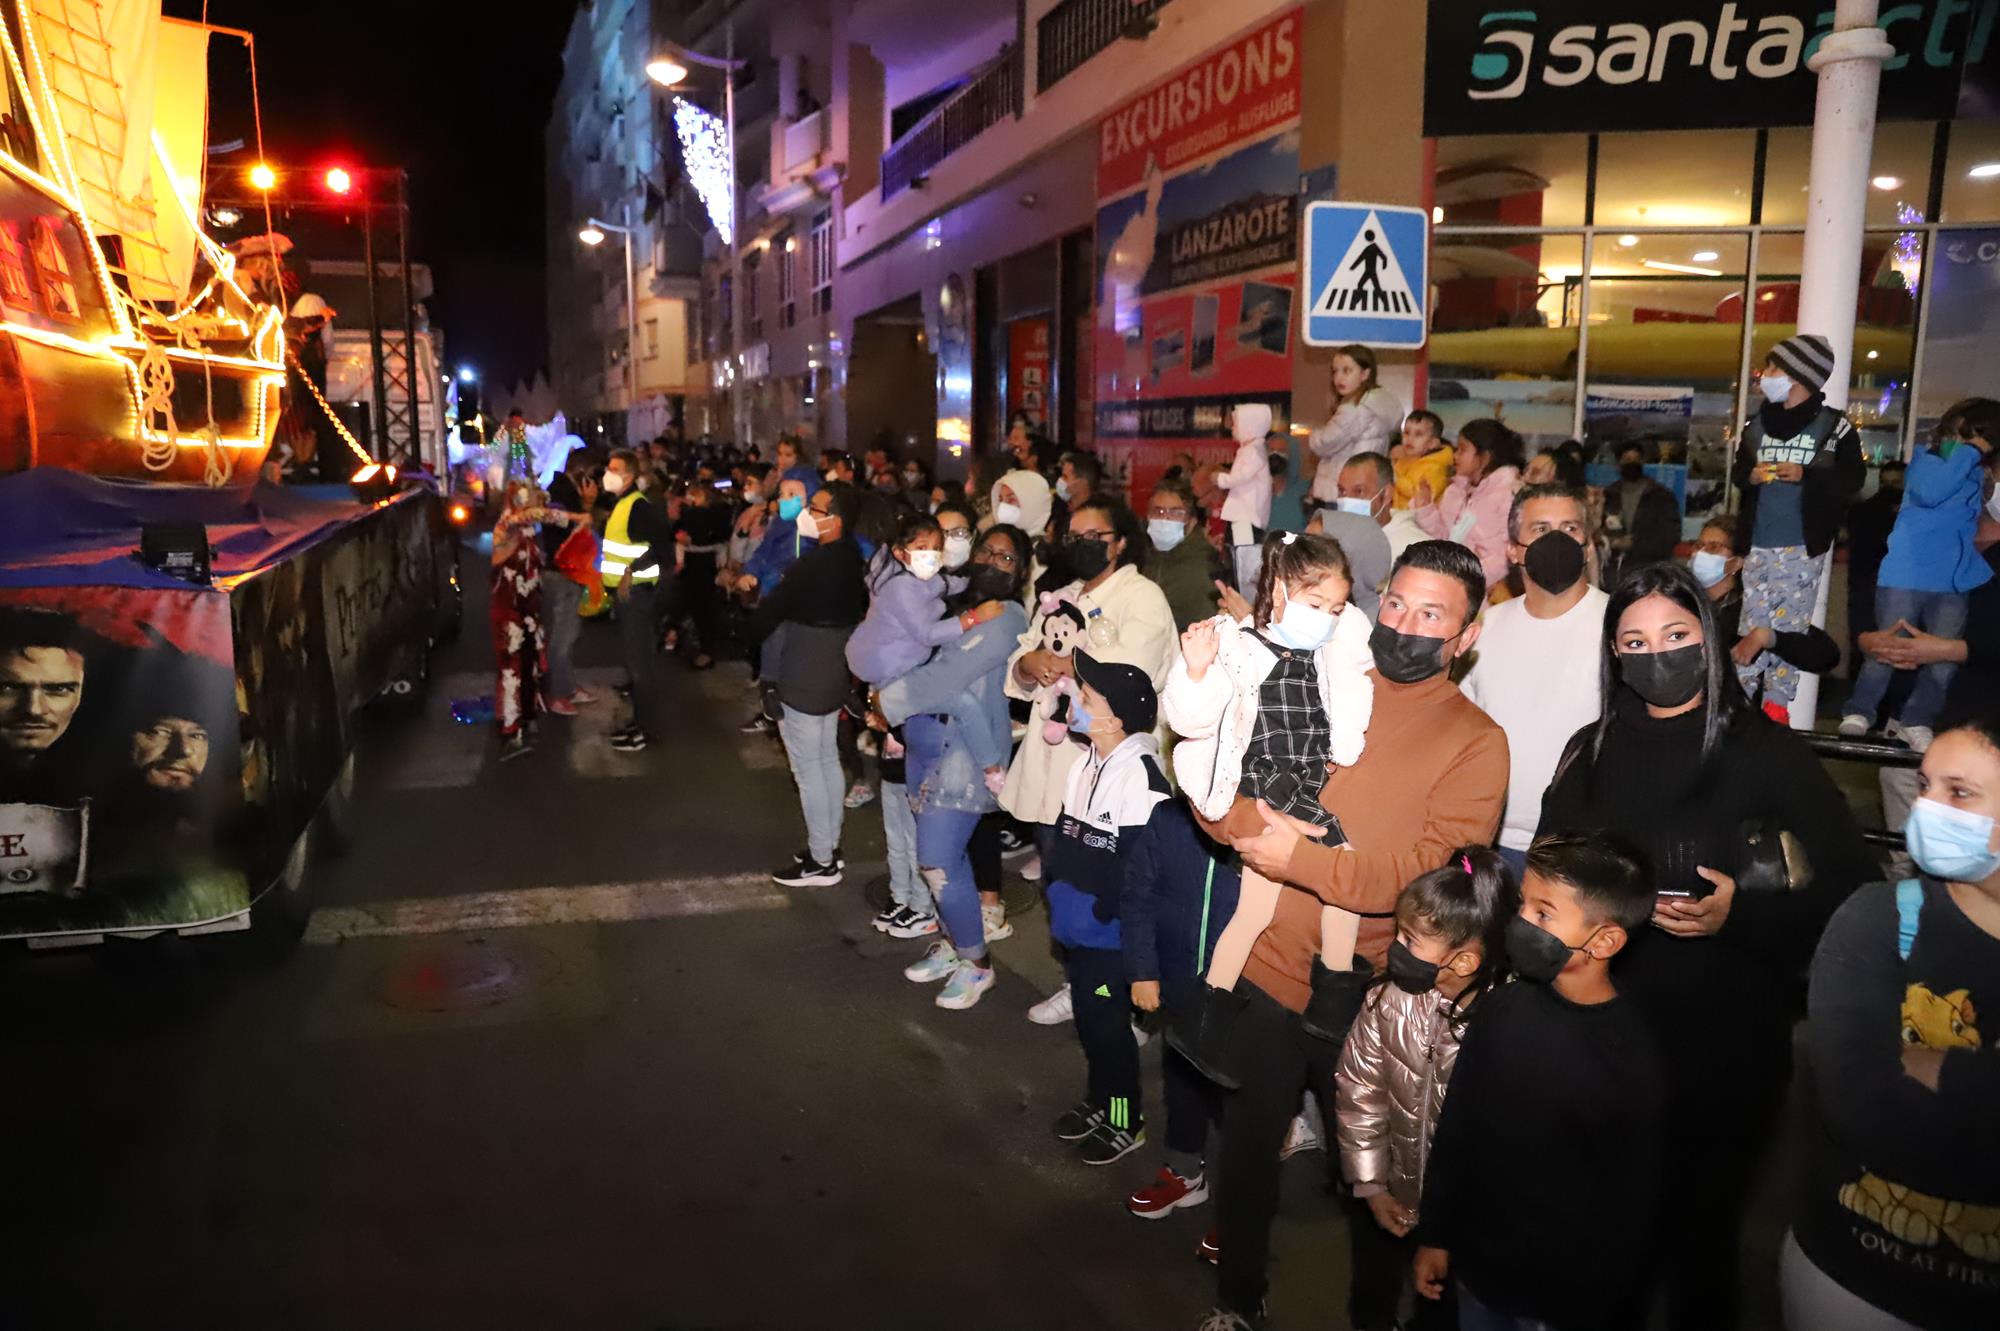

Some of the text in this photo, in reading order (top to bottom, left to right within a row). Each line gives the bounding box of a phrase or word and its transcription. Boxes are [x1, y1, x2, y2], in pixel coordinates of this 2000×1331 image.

[1101, 18, 1295, 164] EXCURSIONS
[1171, 199, 1289, 262] LANZAROTE
[1851, 1226, 1903, 1261] OVE
